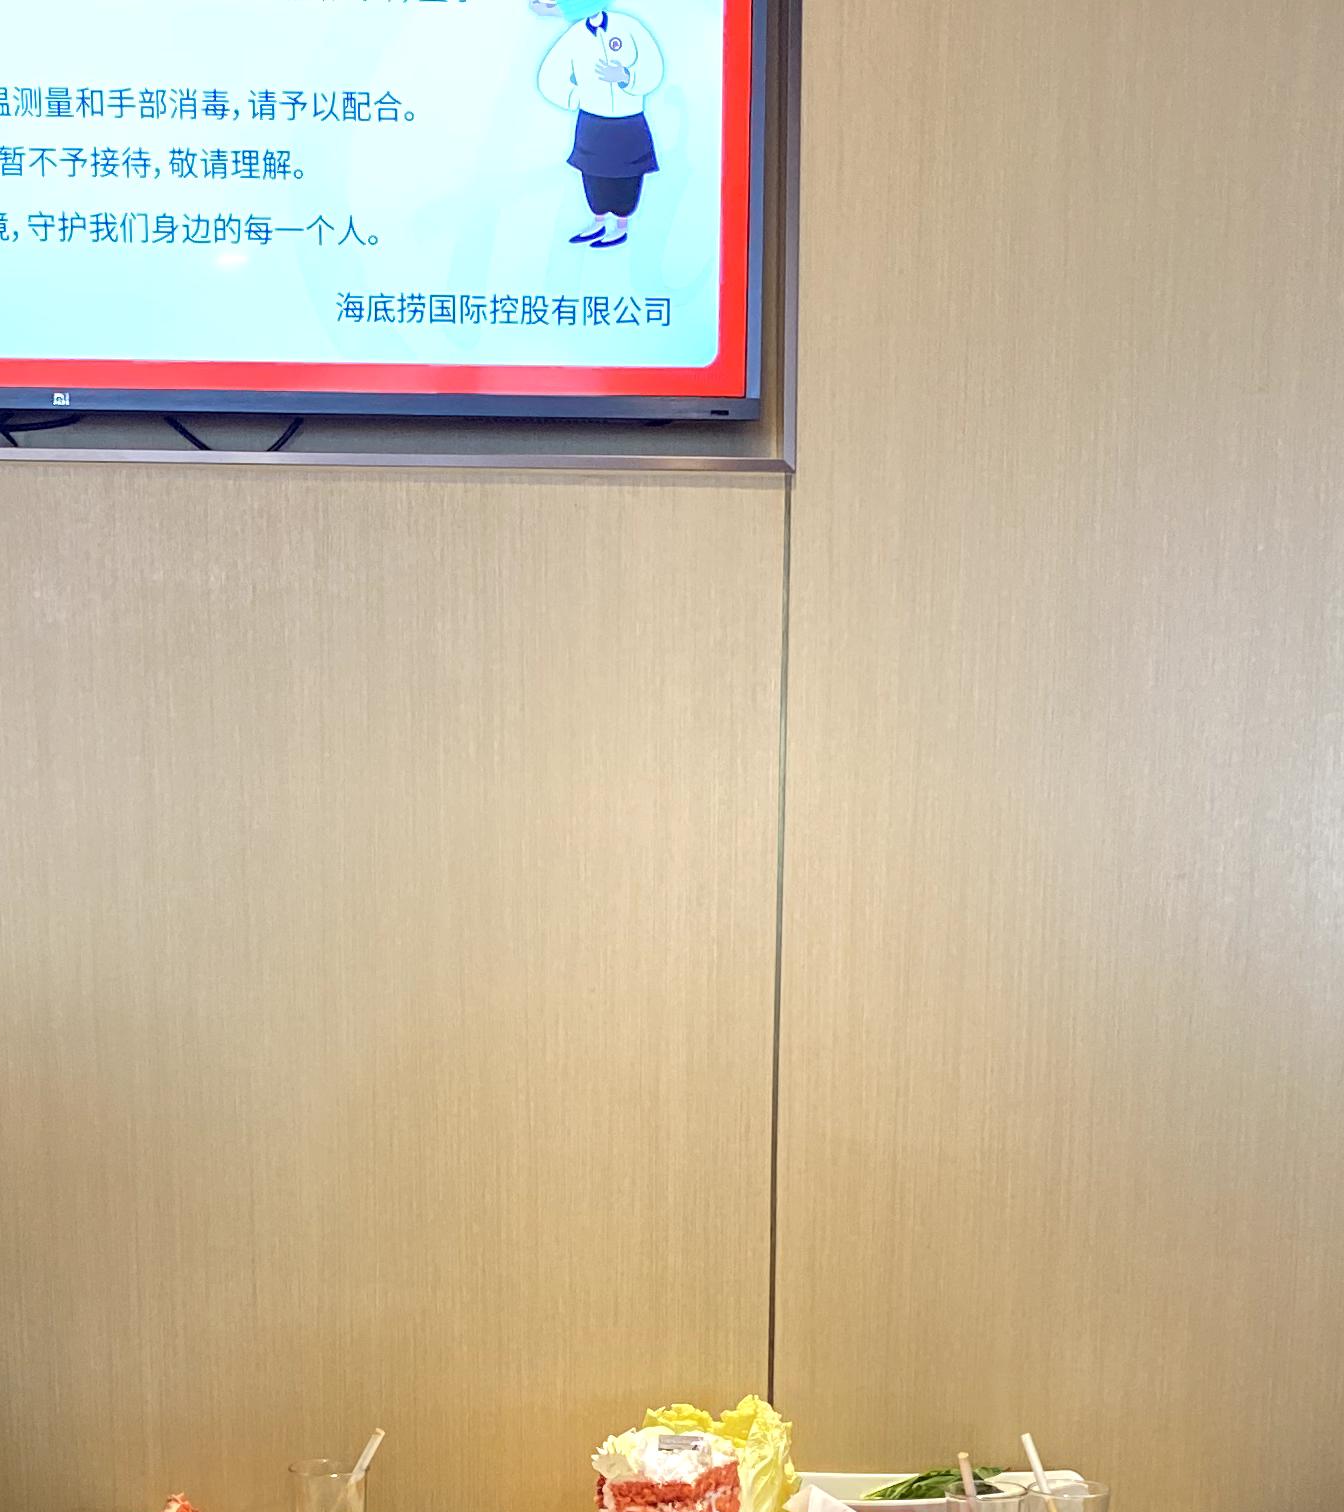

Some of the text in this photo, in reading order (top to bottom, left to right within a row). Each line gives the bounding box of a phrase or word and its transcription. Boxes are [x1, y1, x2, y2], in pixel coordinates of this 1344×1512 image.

[335, 291, 672, 328] 海底捞国际控股有限公司
